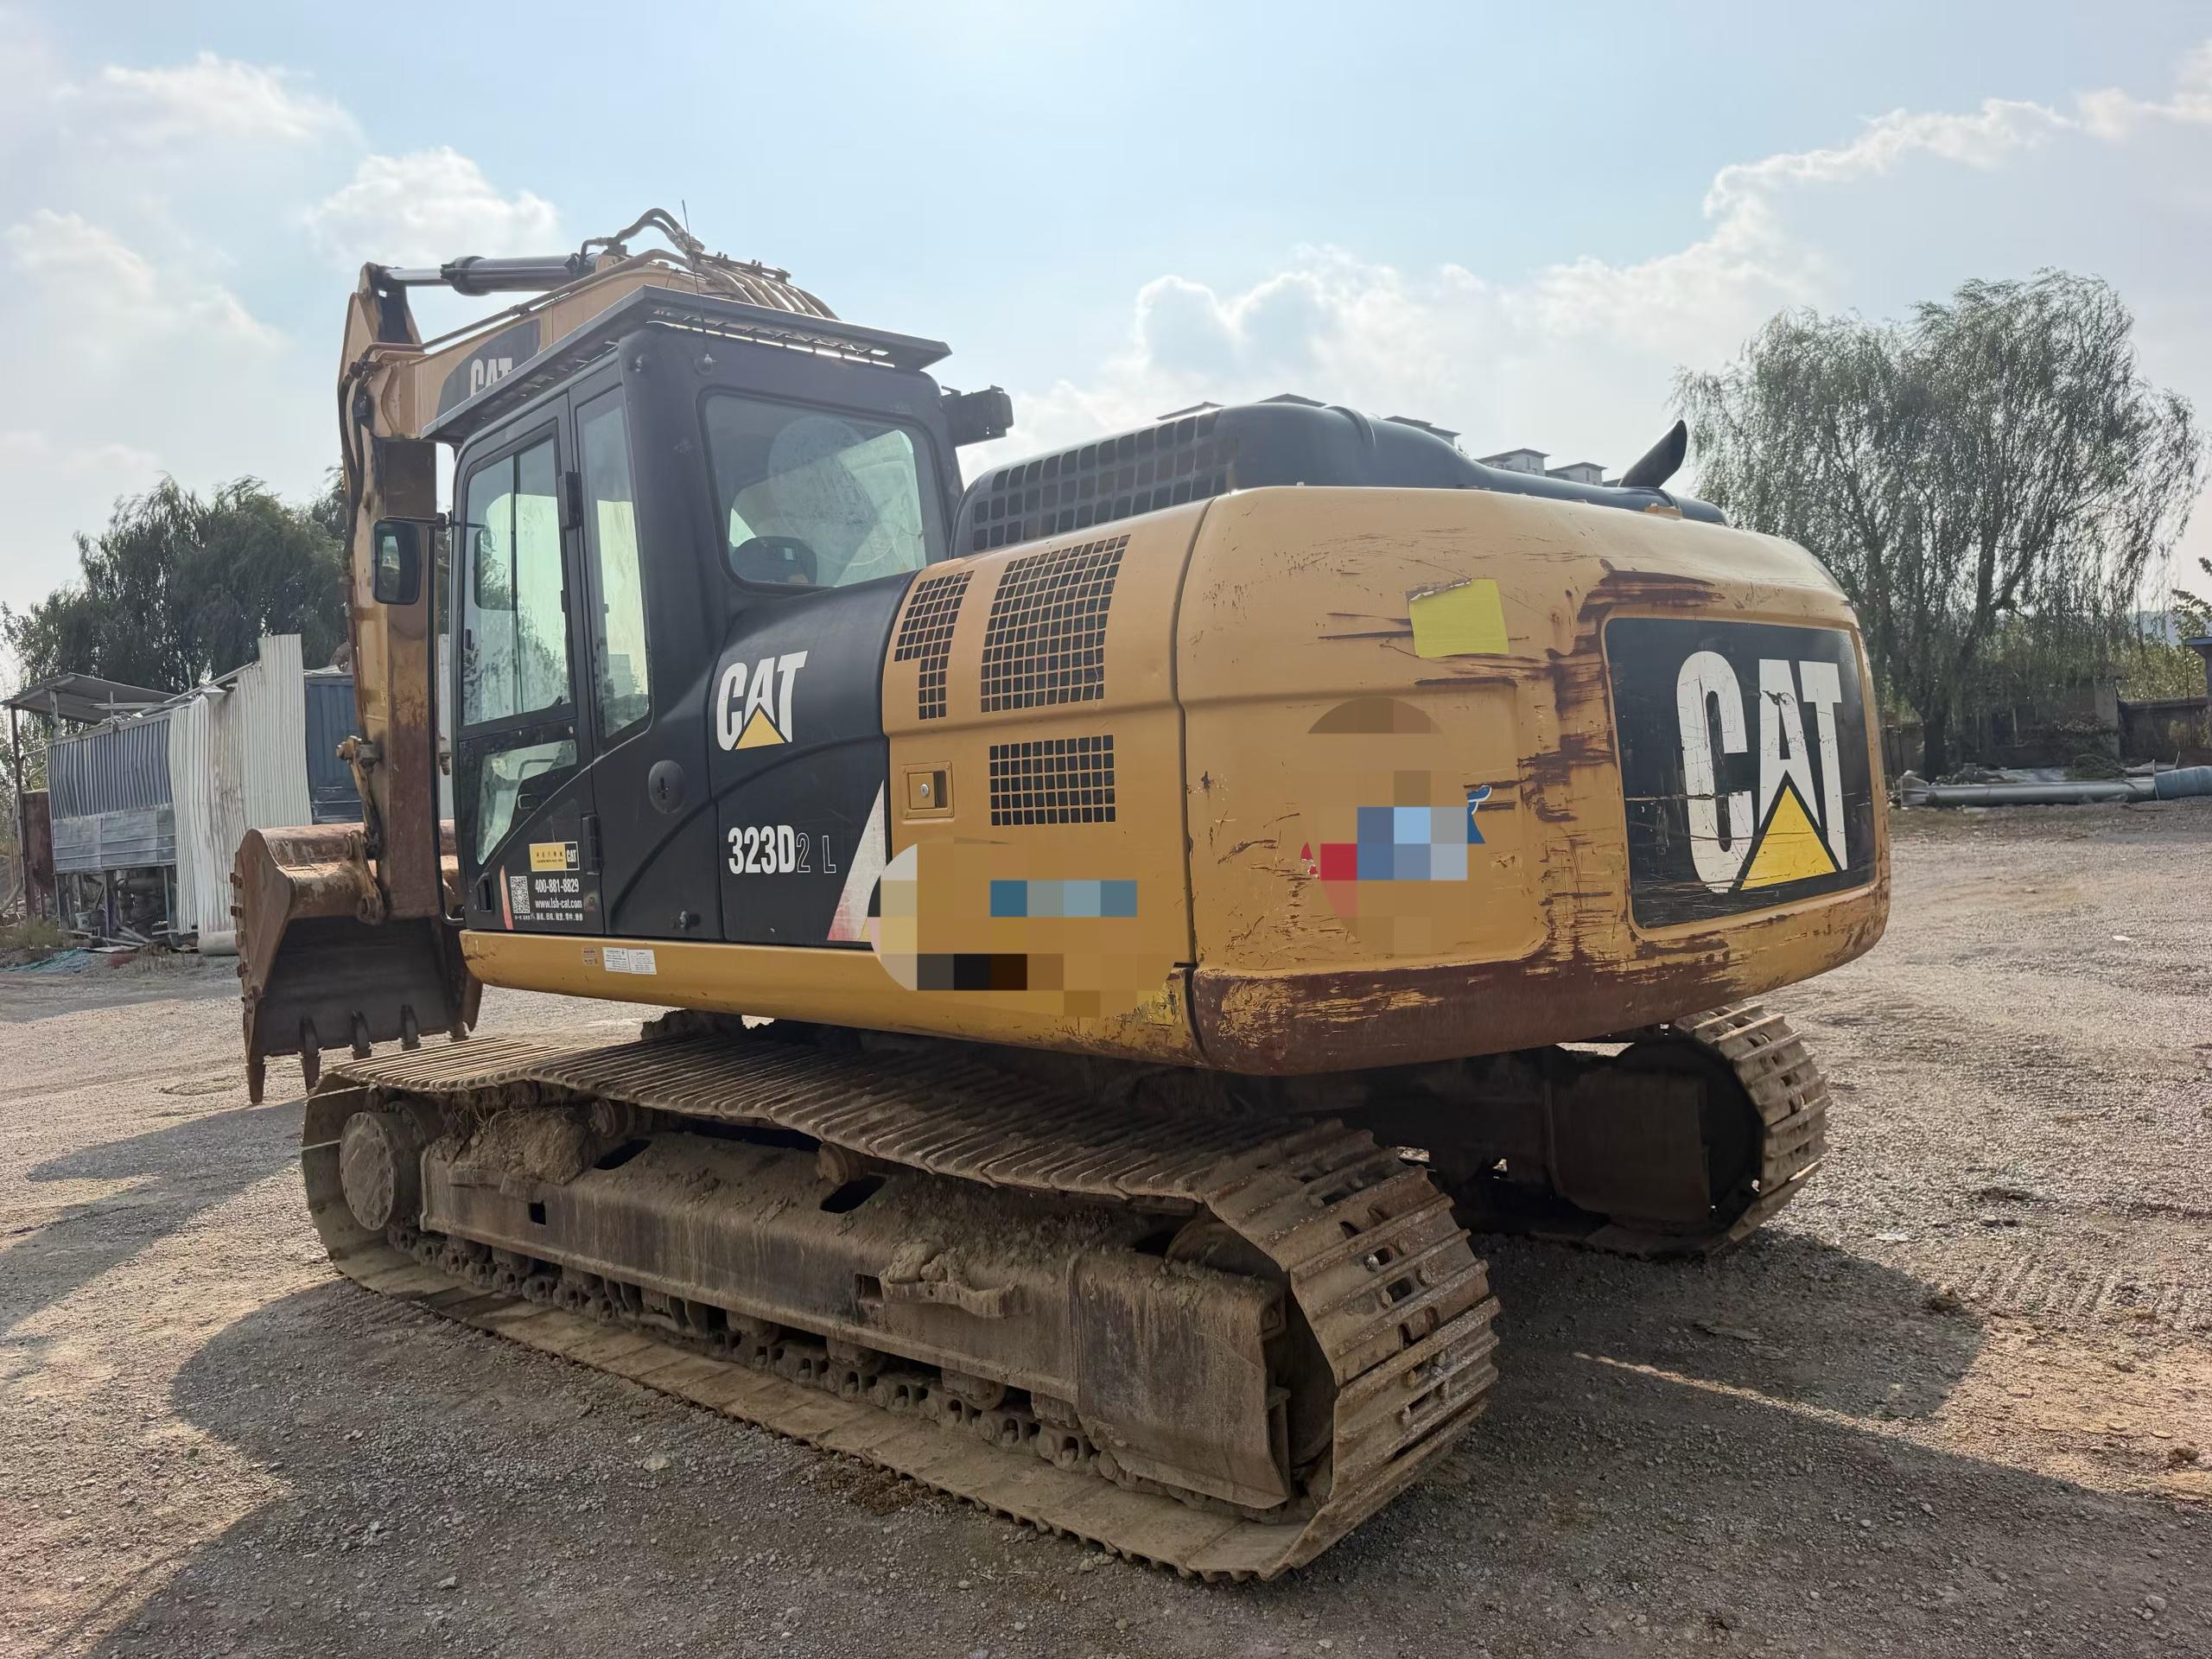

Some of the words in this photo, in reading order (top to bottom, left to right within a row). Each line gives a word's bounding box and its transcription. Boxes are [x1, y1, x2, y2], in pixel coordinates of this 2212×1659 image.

[715, 650, 808, 752] CAT
[1676, 650, 1848, 893] CAT
[566, 849, 577, 863] CAT
[535, 878, 580, 893] 400-881-8829
[535, 897, 583, 909] www.lsh-cat.com
